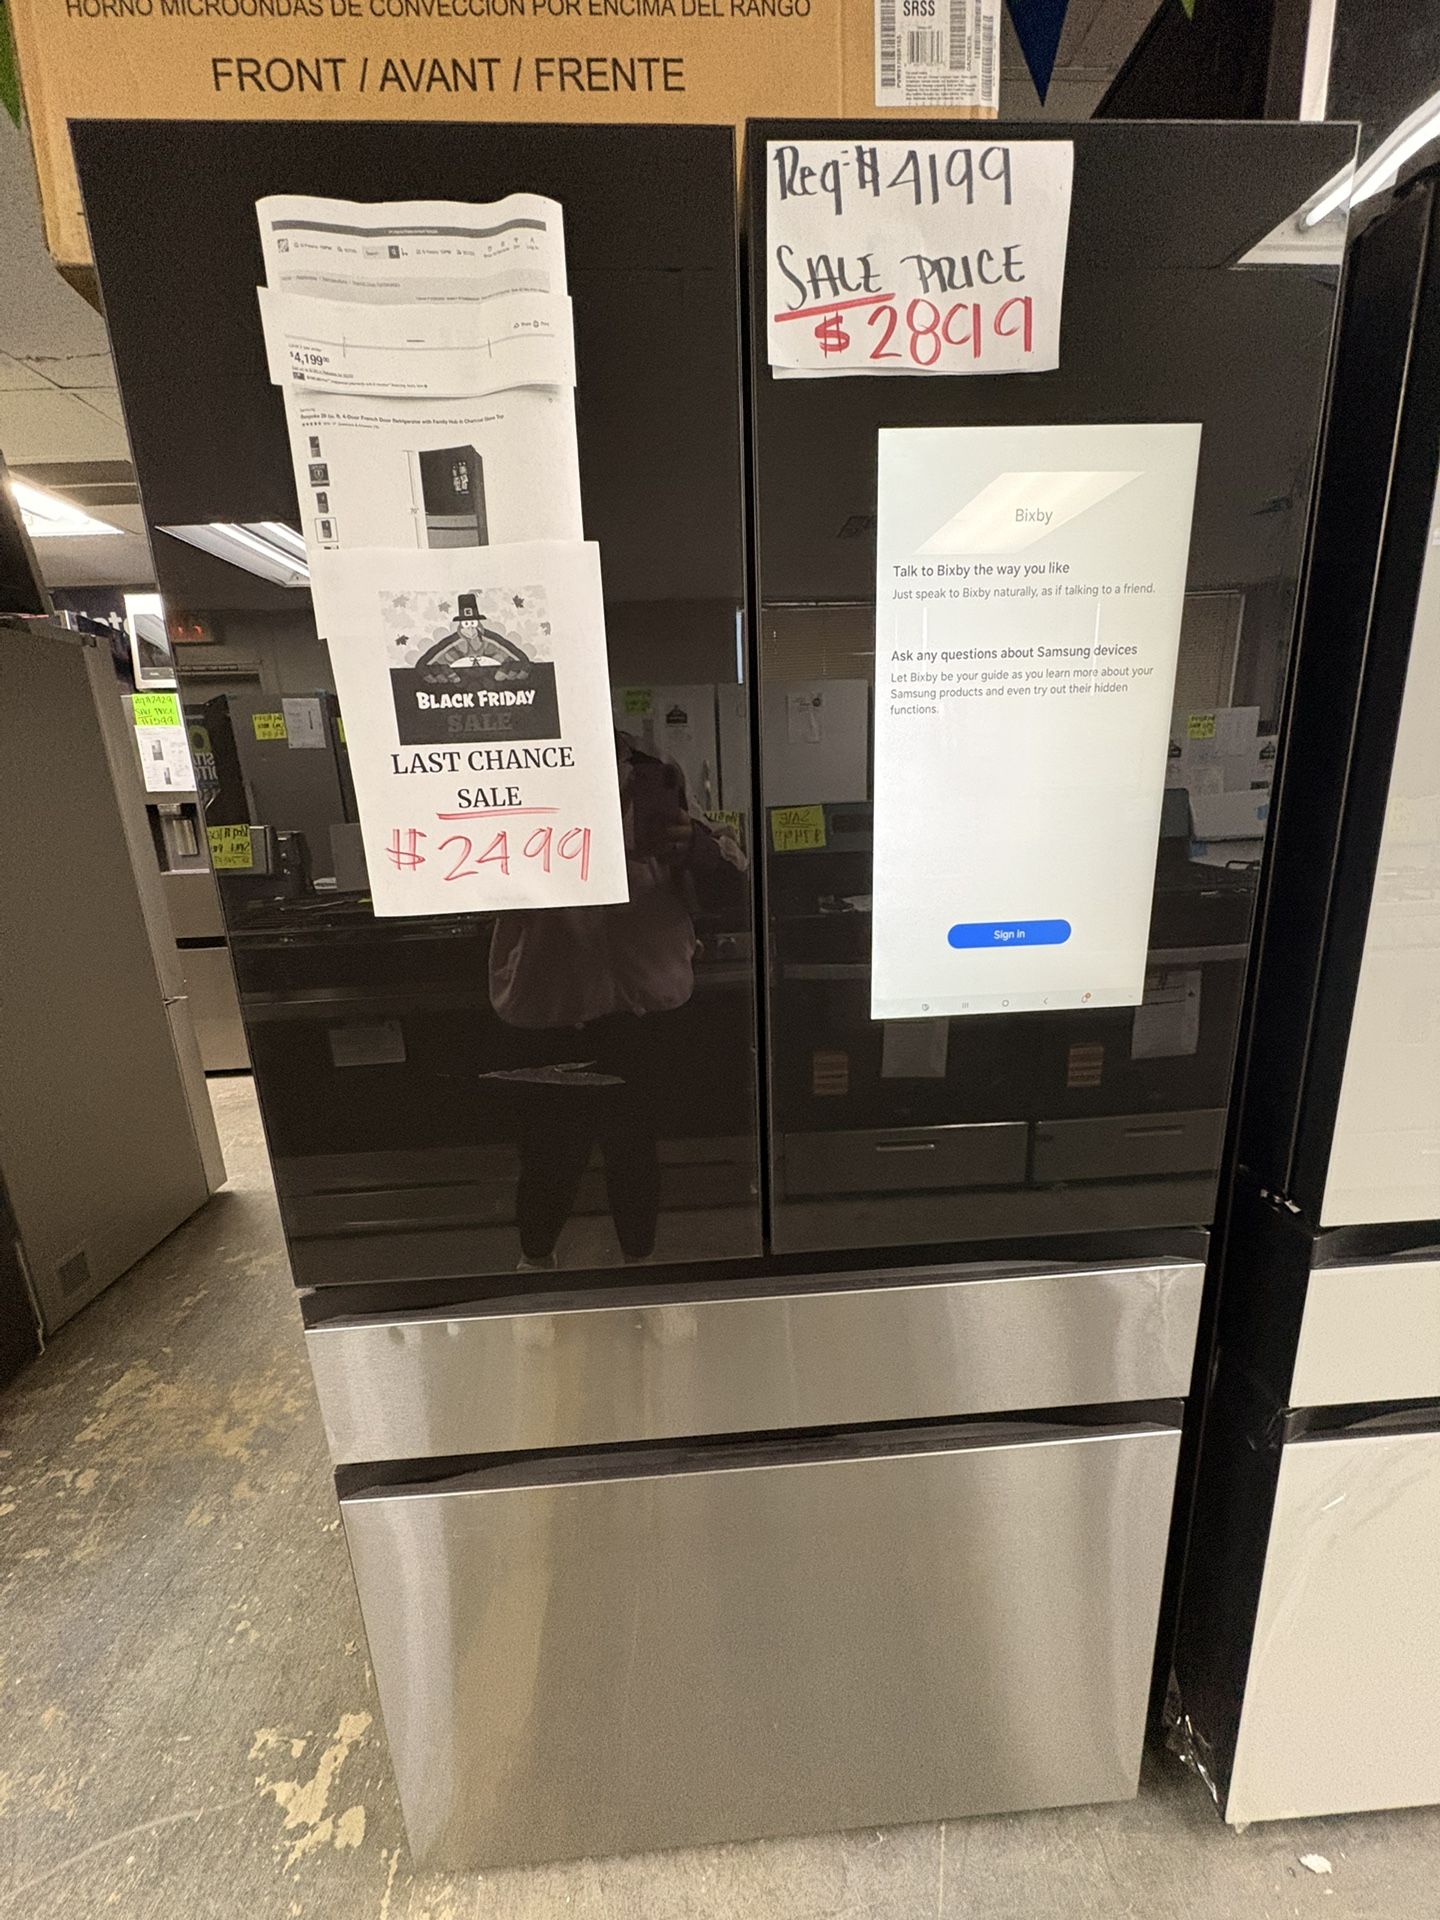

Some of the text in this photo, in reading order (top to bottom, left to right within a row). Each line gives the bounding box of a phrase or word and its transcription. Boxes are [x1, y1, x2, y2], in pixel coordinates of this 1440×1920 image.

[66, 0, 152, 17] HORNO
[161, 0, 324, 17] MICROONDAS
[331, 0, 363, 17] DE
[532, 0, 582, 17] POR
[588, 0, 676, 17] ENCIMA
[681, 0, 725, 17] DEL
[730, 0, 811, 17] RANGO
[211, 57, 347, 93] FRONT
[379, 57, 501, 93] AVANT
[535, 57, 686, 92] FRENTE
[776, 244, 1026, 311] SALE PRICE
[1015, 508, 1053, 526] Bixby
[893, 562, 1070, 579] Talk to Bixby the way you like
[892, 583, 1156, 601] Just speak to Bixby naturally, as if talking to a friend.
[891, 644, 1138, 664] Ask any questions about Samsung devices
[890, 666, 1154, 684] Let Bixby be your guide as you learn more about your
[416, 690, 536, 711] BLACK FRIDAY
[890, 683, 1128, 700] Samsung products and even try out their hidden
[890, 704, 939, 715] functions.
[448, 712, 513, 734] SALE
[391, 746, 575, 775] LAST CHANCE
[457, 786, 522, 808] SALE
[993, 929, 1015, 941] Sign
